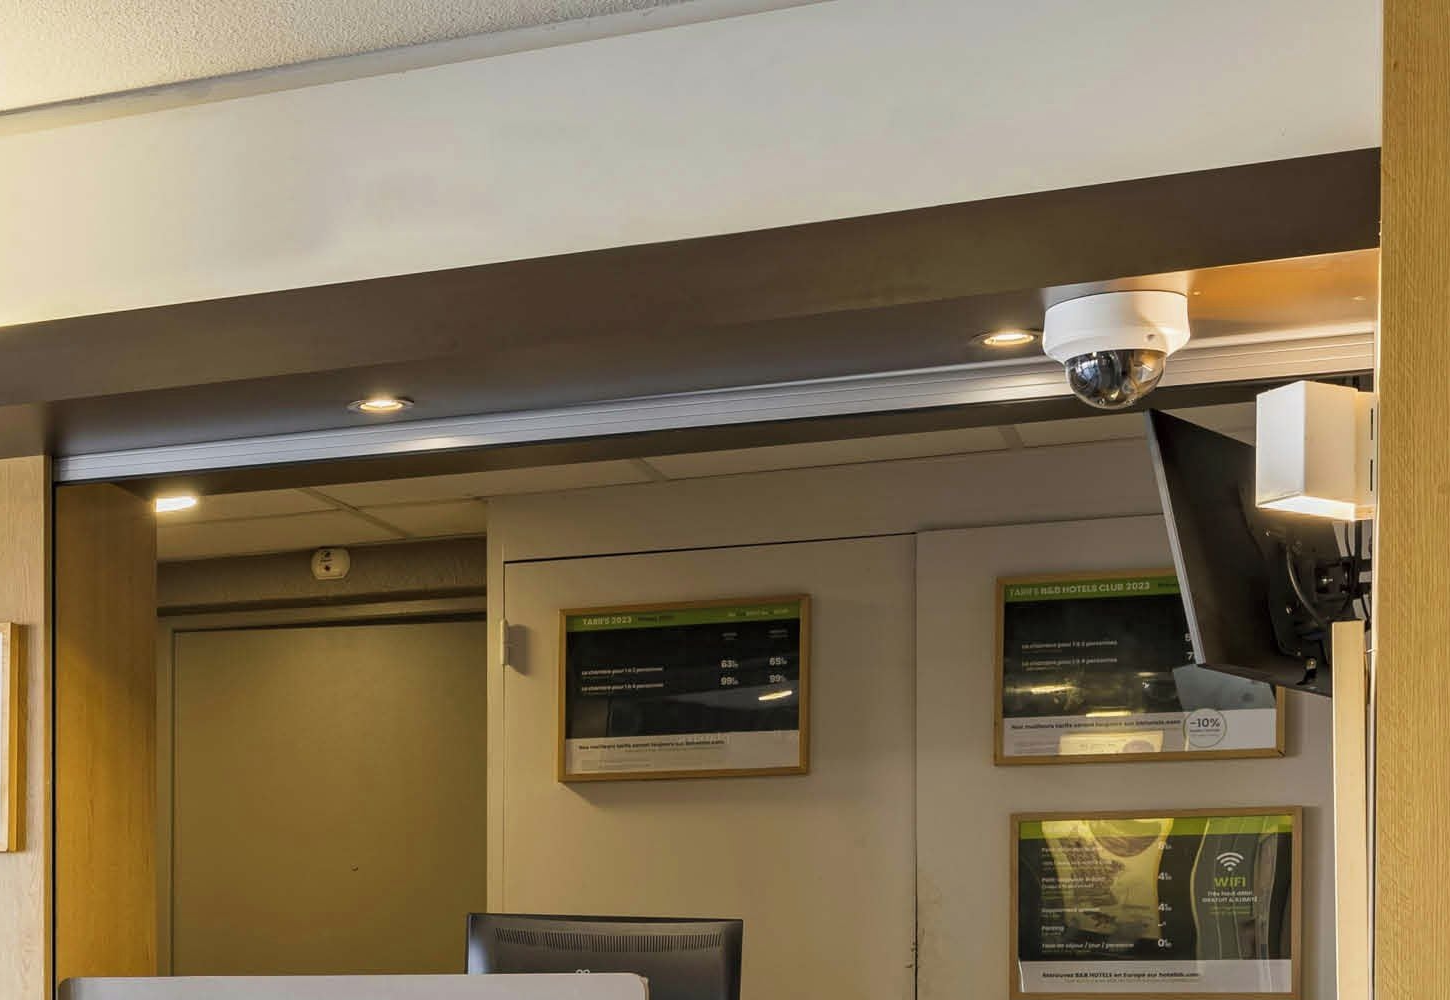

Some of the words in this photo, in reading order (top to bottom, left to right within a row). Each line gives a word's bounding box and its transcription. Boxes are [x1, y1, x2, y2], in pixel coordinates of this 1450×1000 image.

[1062, 584, 1097, 593] HOTELS
[1098, 582, 1124, 592] CLUB
[1126, 581, 1150, 590] 2023
[1190, 718, 1220, 727] -10%
